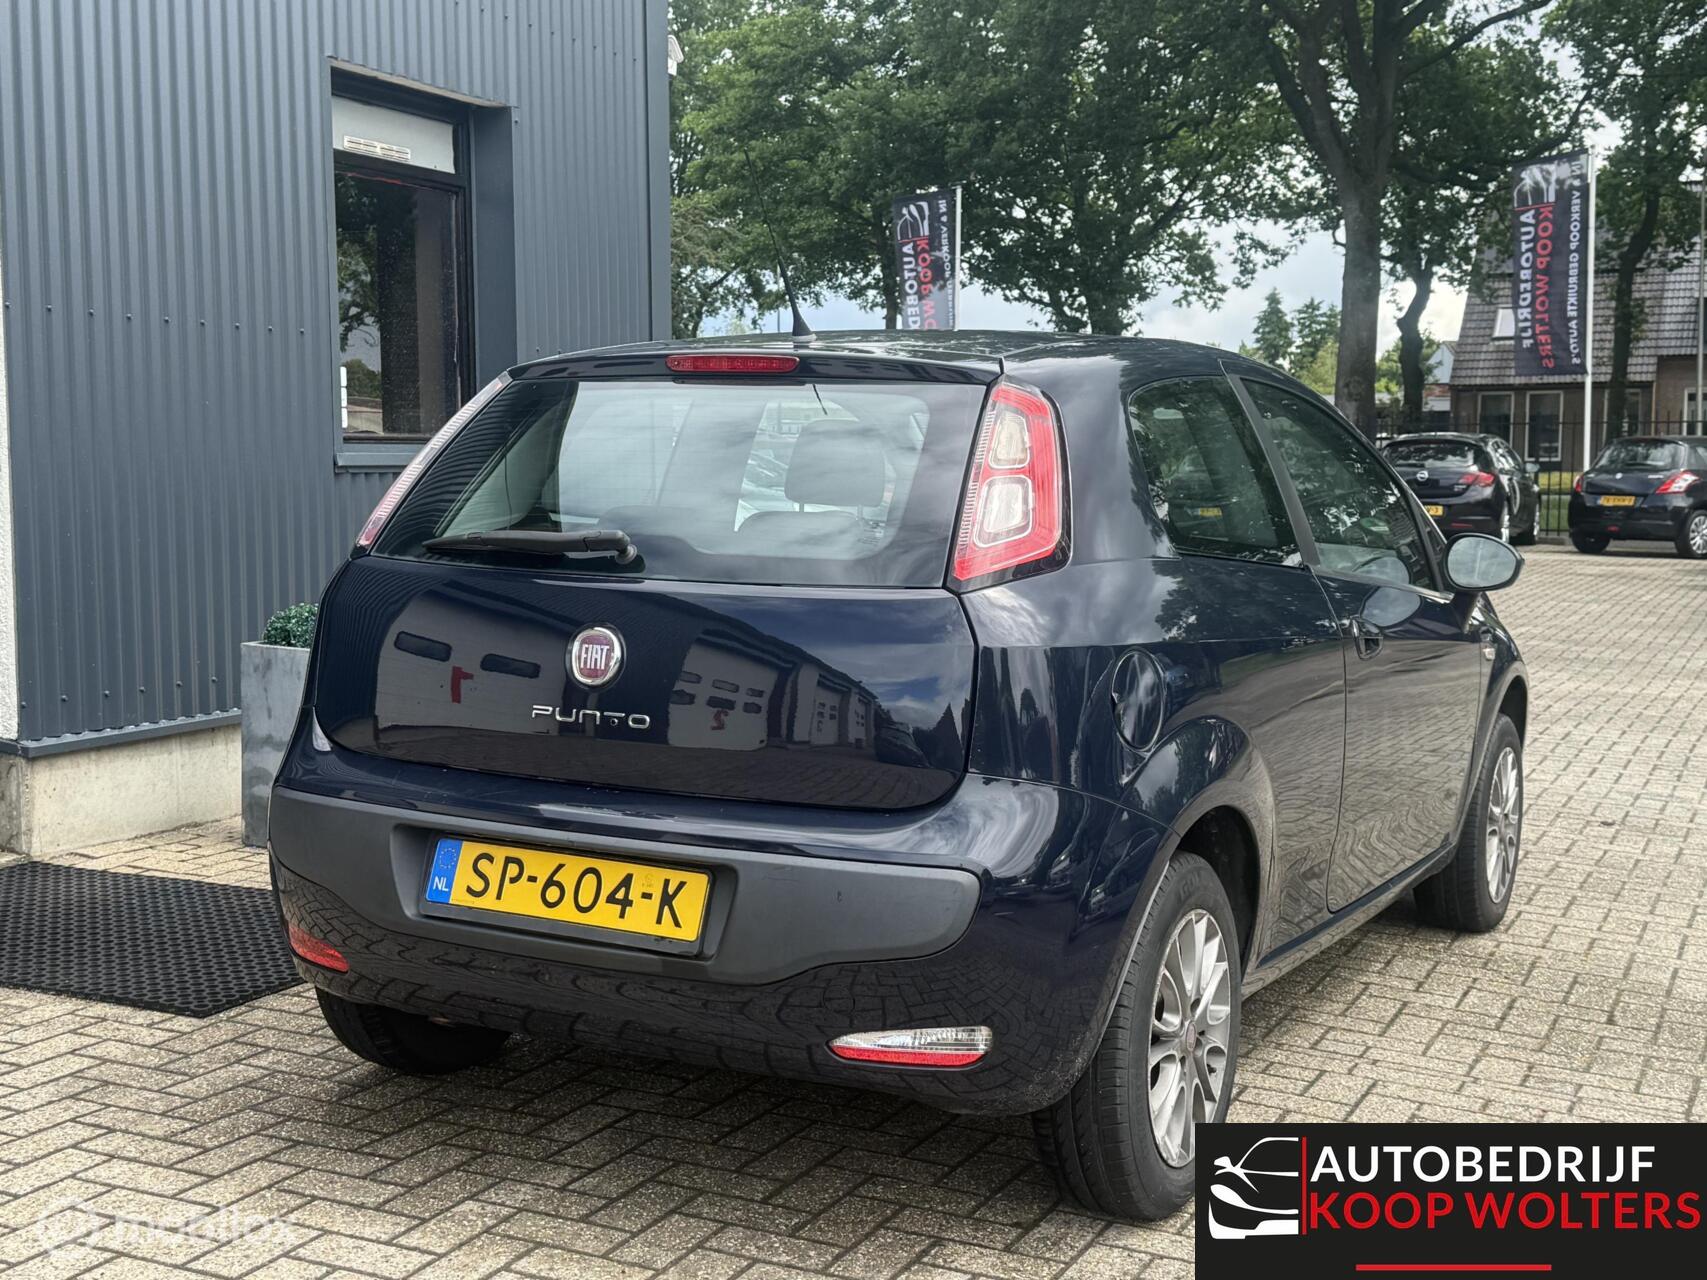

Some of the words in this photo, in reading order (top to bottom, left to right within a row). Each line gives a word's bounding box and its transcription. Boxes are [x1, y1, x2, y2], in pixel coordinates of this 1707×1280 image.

[580, 644, 610, 670] FIAT
[433, 876, 450, 893] NL
[465, 852, 688, 929] SP-604-K
